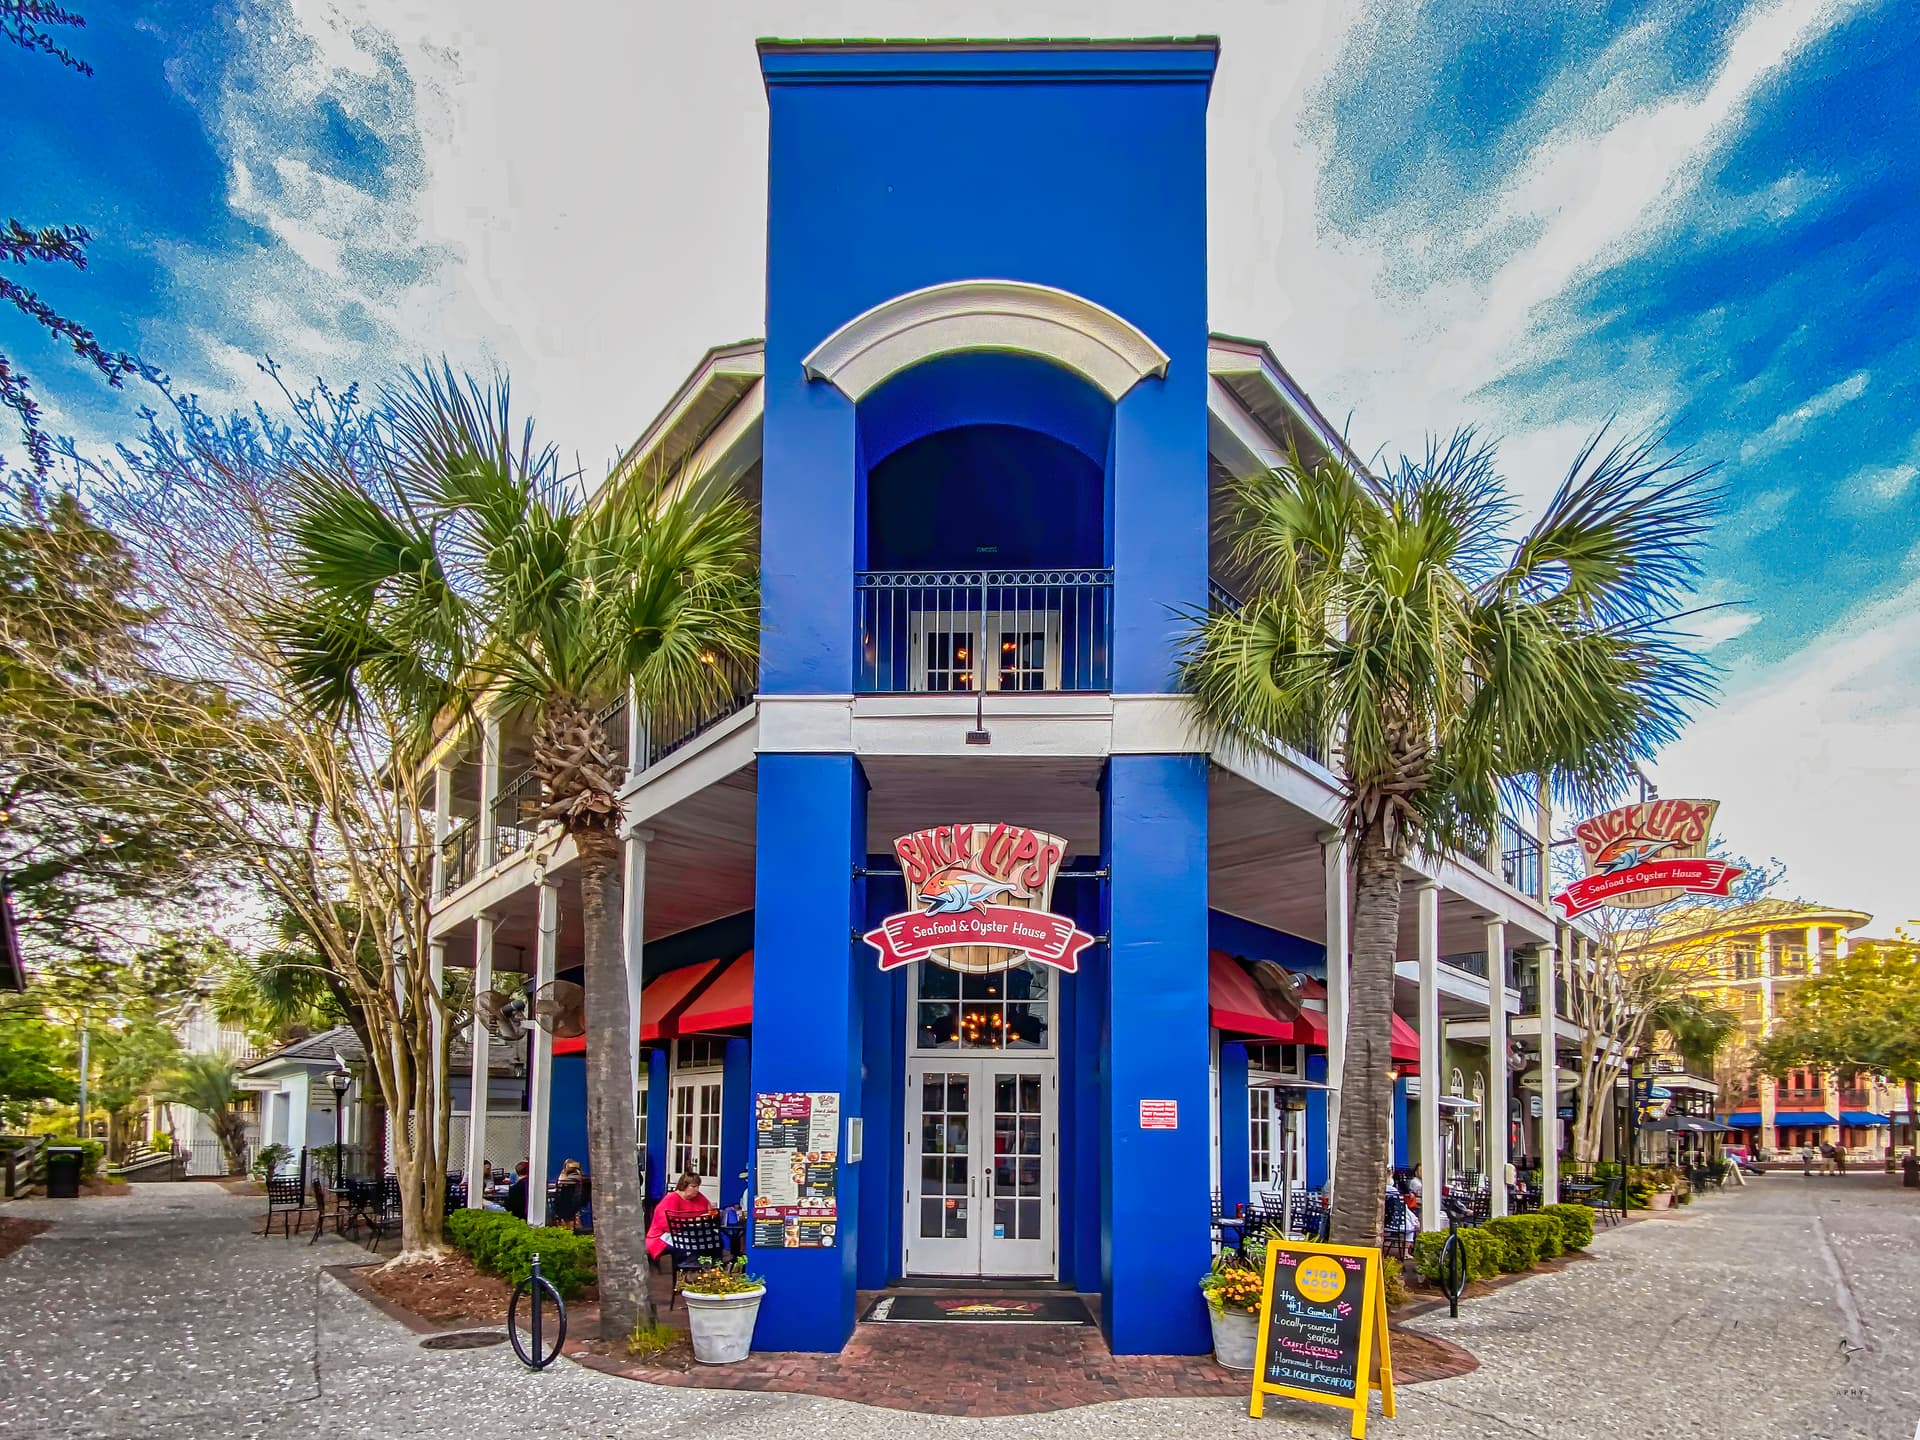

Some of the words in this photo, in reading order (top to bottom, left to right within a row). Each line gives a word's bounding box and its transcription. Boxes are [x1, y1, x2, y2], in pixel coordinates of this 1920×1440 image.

[1588, 876, 1624, 894] Seafood
[1625, 874, 1636, 883] &
[1635, 871, 1668, 884] Oyster
[1671, 868, 1702, 878] House
[912, 919, 957, 938] Seafood
[959, 920, 970, 931] &
[970, 919, 1008, 936] Oyster
[1012, 921, 1047, 939] House
[1280, 1290, 1296, 1301] the
[1286, 1300, 1304, 1314] #1
[1307, 1333, 1340, 1345] seafood
